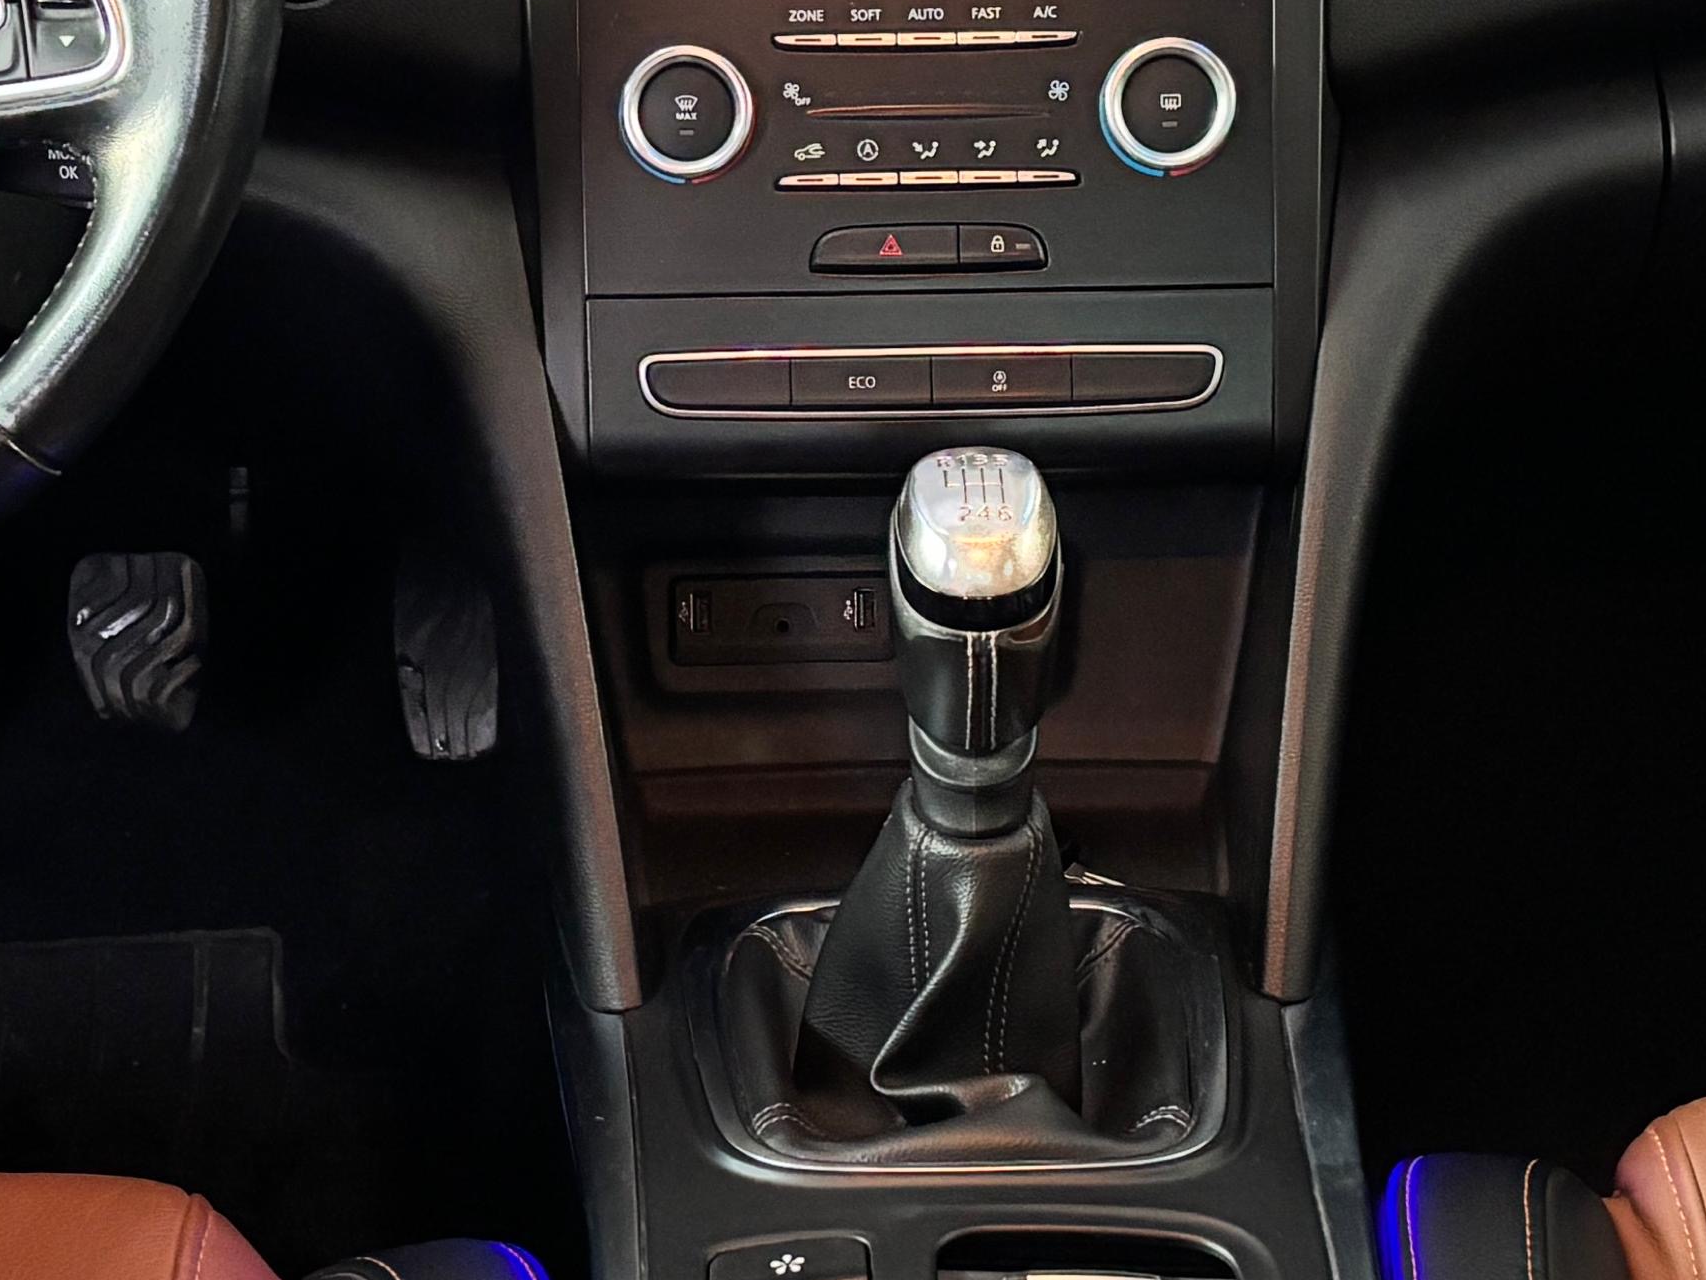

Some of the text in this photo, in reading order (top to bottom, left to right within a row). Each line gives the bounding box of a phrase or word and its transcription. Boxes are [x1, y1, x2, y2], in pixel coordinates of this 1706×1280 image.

[788, 9, 825, 22] ZONE
[850, 8, 882, 21] SOFT
[907, 7, 944, 20] AUTO
[971, 7, 1002, 20] FAST
[1033, 5, 1058, 18] A/C
[675, 112, 697, 121] MAX
[59, 165, 79, 179] OK
[848, 376, 876, 389] ECO
[991, 383, 1007, 392] OFF
